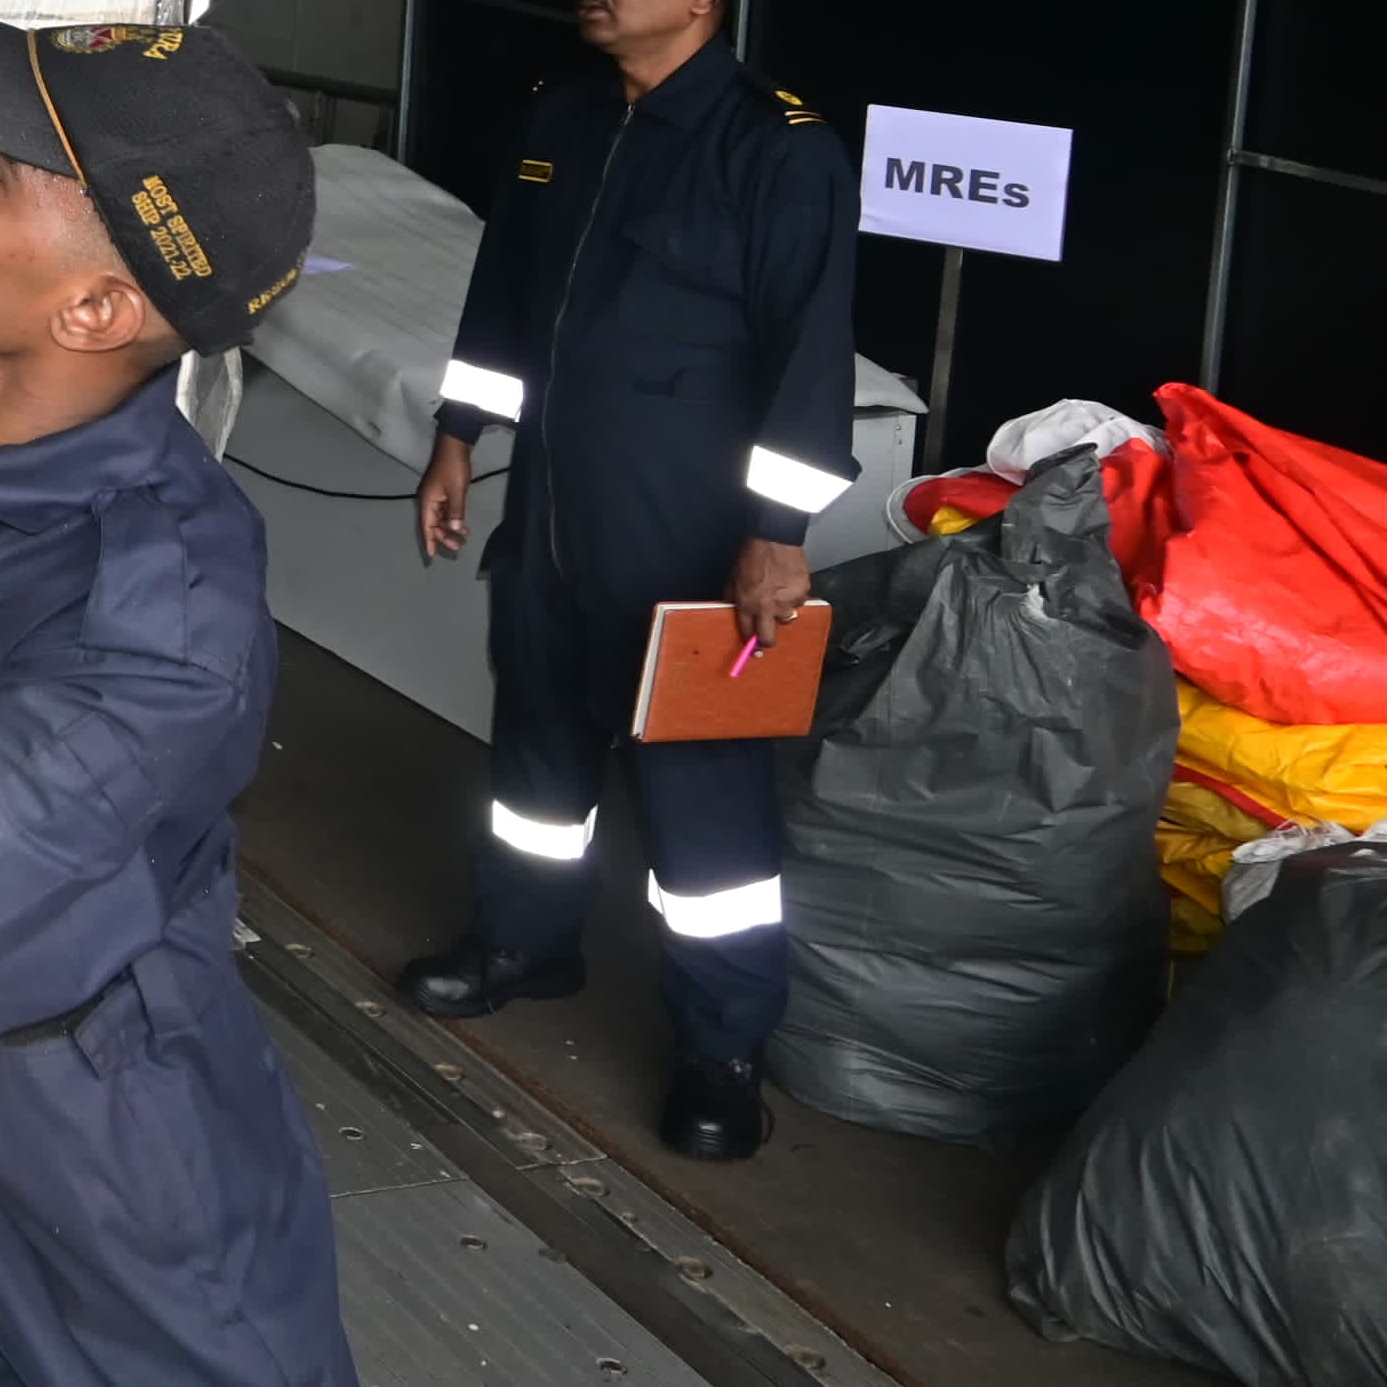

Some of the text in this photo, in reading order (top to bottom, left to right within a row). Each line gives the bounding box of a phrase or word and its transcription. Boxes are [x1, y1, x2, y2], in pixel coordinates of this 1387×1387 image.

[884, 157, 1030, 208] MREs
[131, 191, 161, 226] SHIP
[142, 174, 213, 277] MOST SPIRITED
